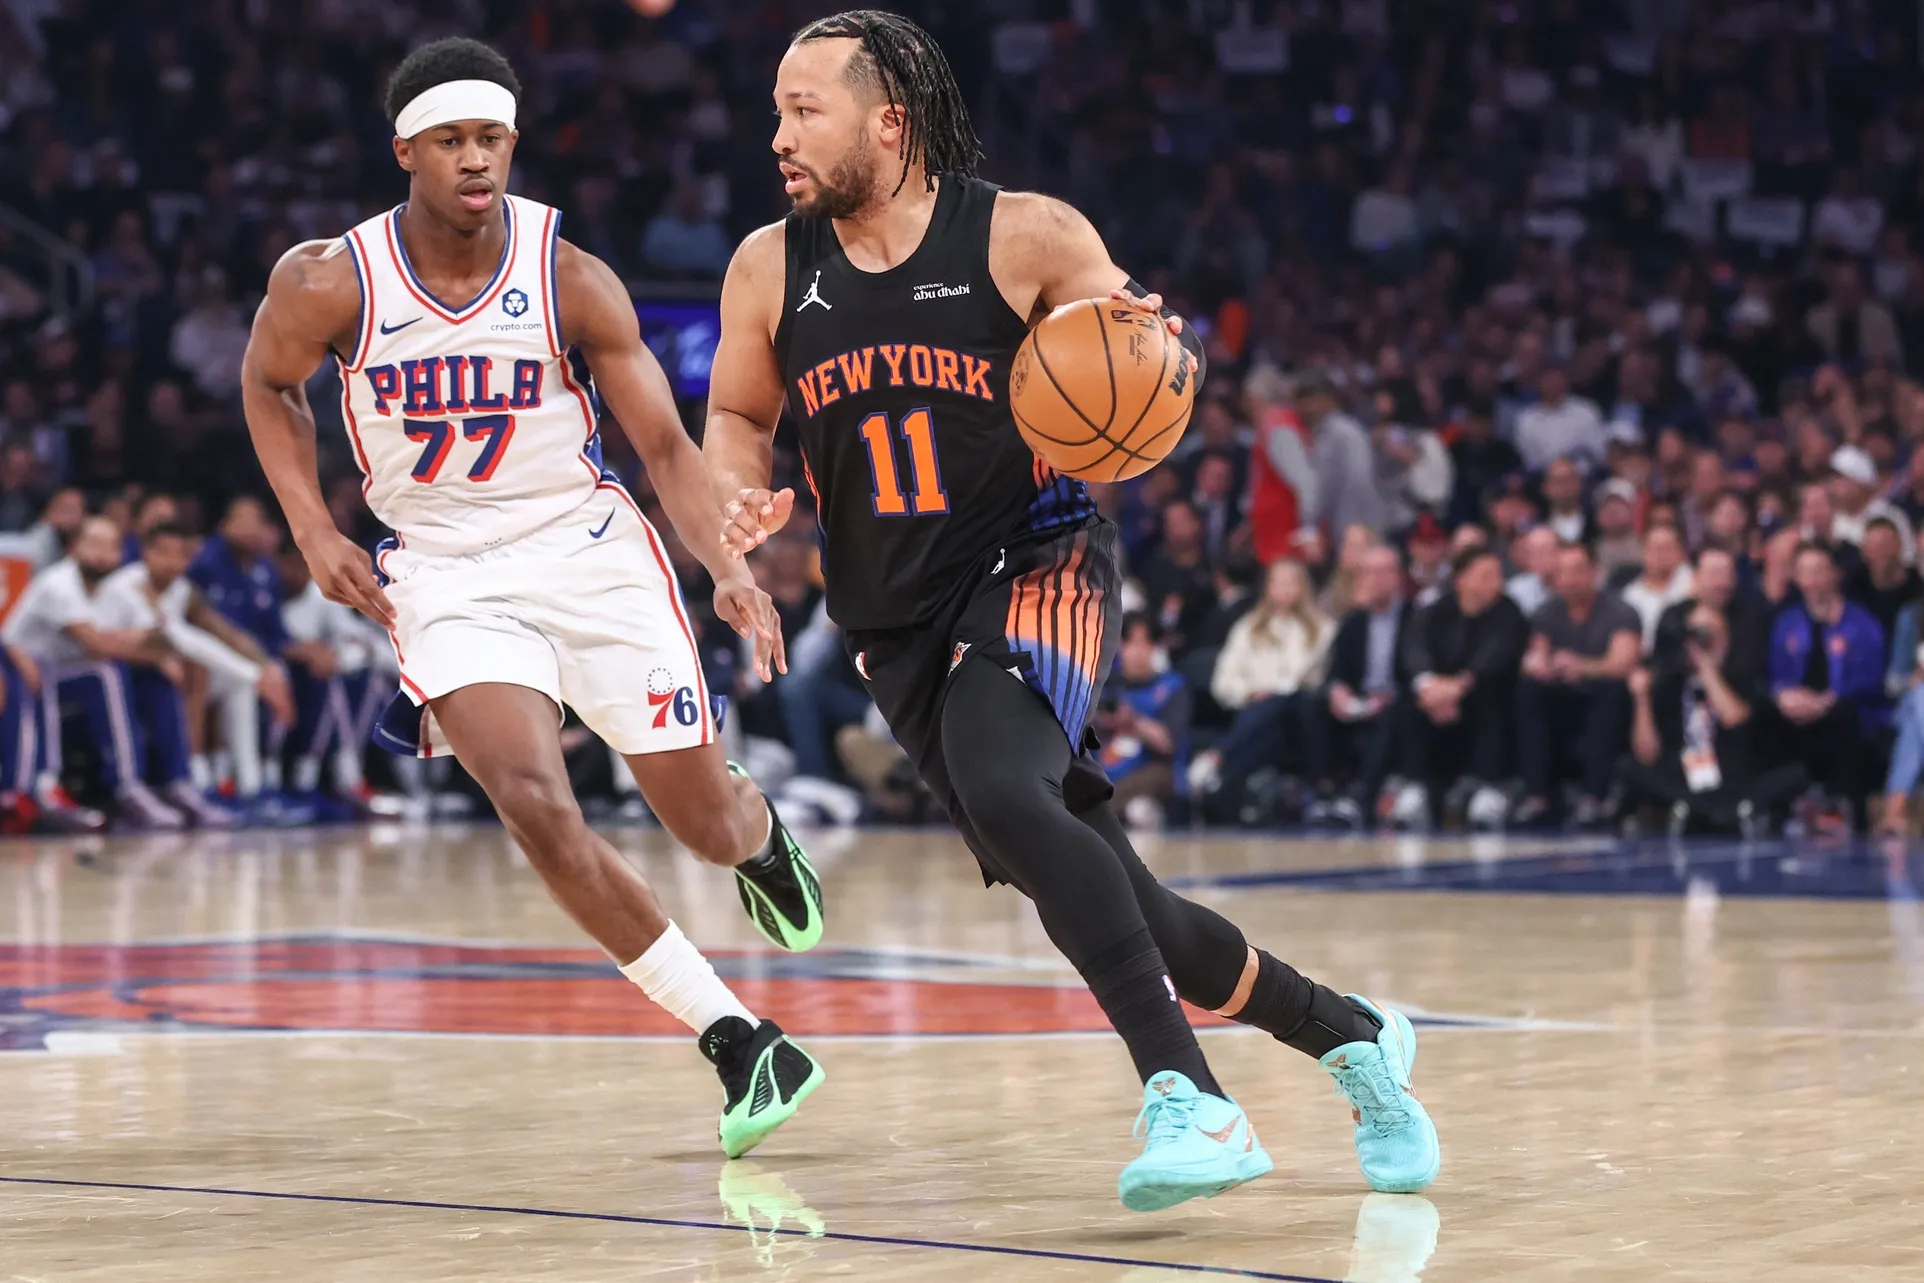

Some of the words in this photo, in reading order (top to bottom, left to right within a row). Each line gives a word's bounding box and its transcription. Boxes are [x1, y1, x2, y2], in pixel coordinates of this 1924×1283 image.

[913, 282, 944, 291] experience
[913, 290, 936, 301] abu
[937, 283, 970, 298] dhabi
[490, 323, 542, 332] crypto.com
[364, 355, 544, 417] PHILA
[797, 347, 875, 419] NEW
[879, 343, 995, 401] YORK
[403, 414, 516, 484] 77
[857, 406, 950, 517] 11
[647, 686, 699, 730] 76
